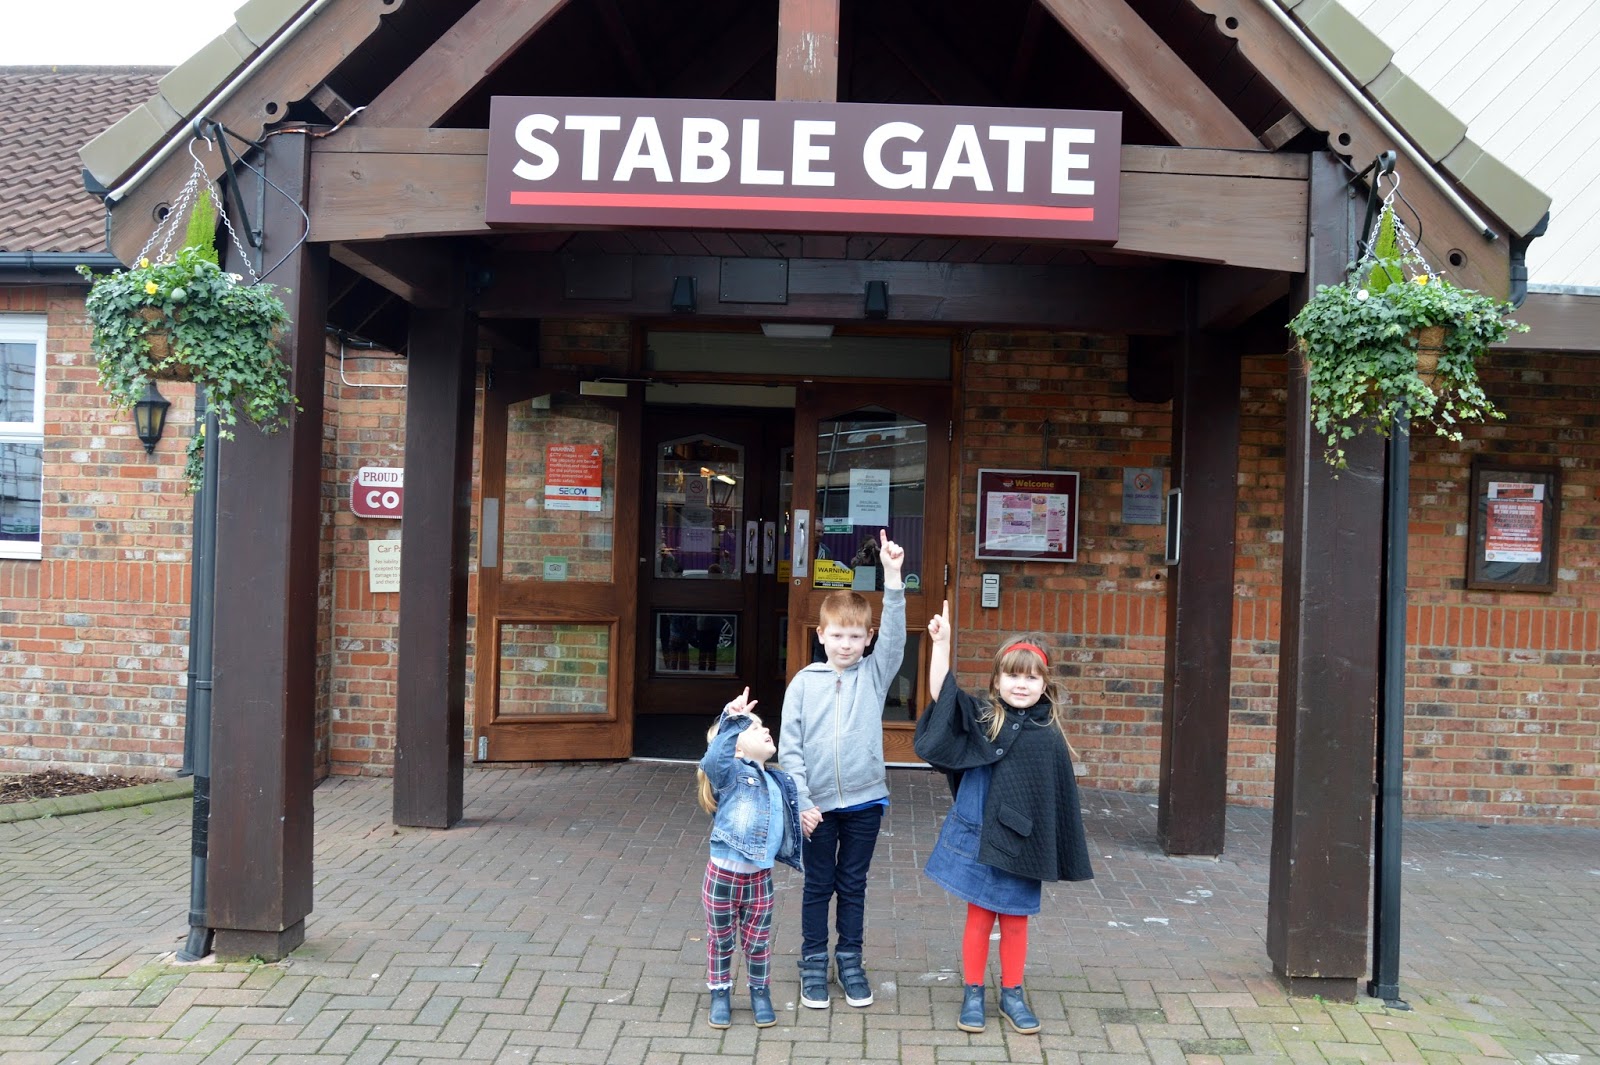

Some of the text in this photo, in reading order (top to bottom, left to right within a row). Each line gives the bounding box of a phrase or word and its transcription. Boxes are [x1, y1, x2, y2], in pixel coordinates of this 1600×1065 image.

[512, 113, 1096, 196] STABLE GATE
[362, 471, 398, 483] PROUD
[1014, 479, 1055, 488] Welcome
[559, 487, 587, 496] SECOM
[365, 490, 400, 509] CO
[377, 545, 391, 553] Car
[817, 566, 850, 575] WARNING
